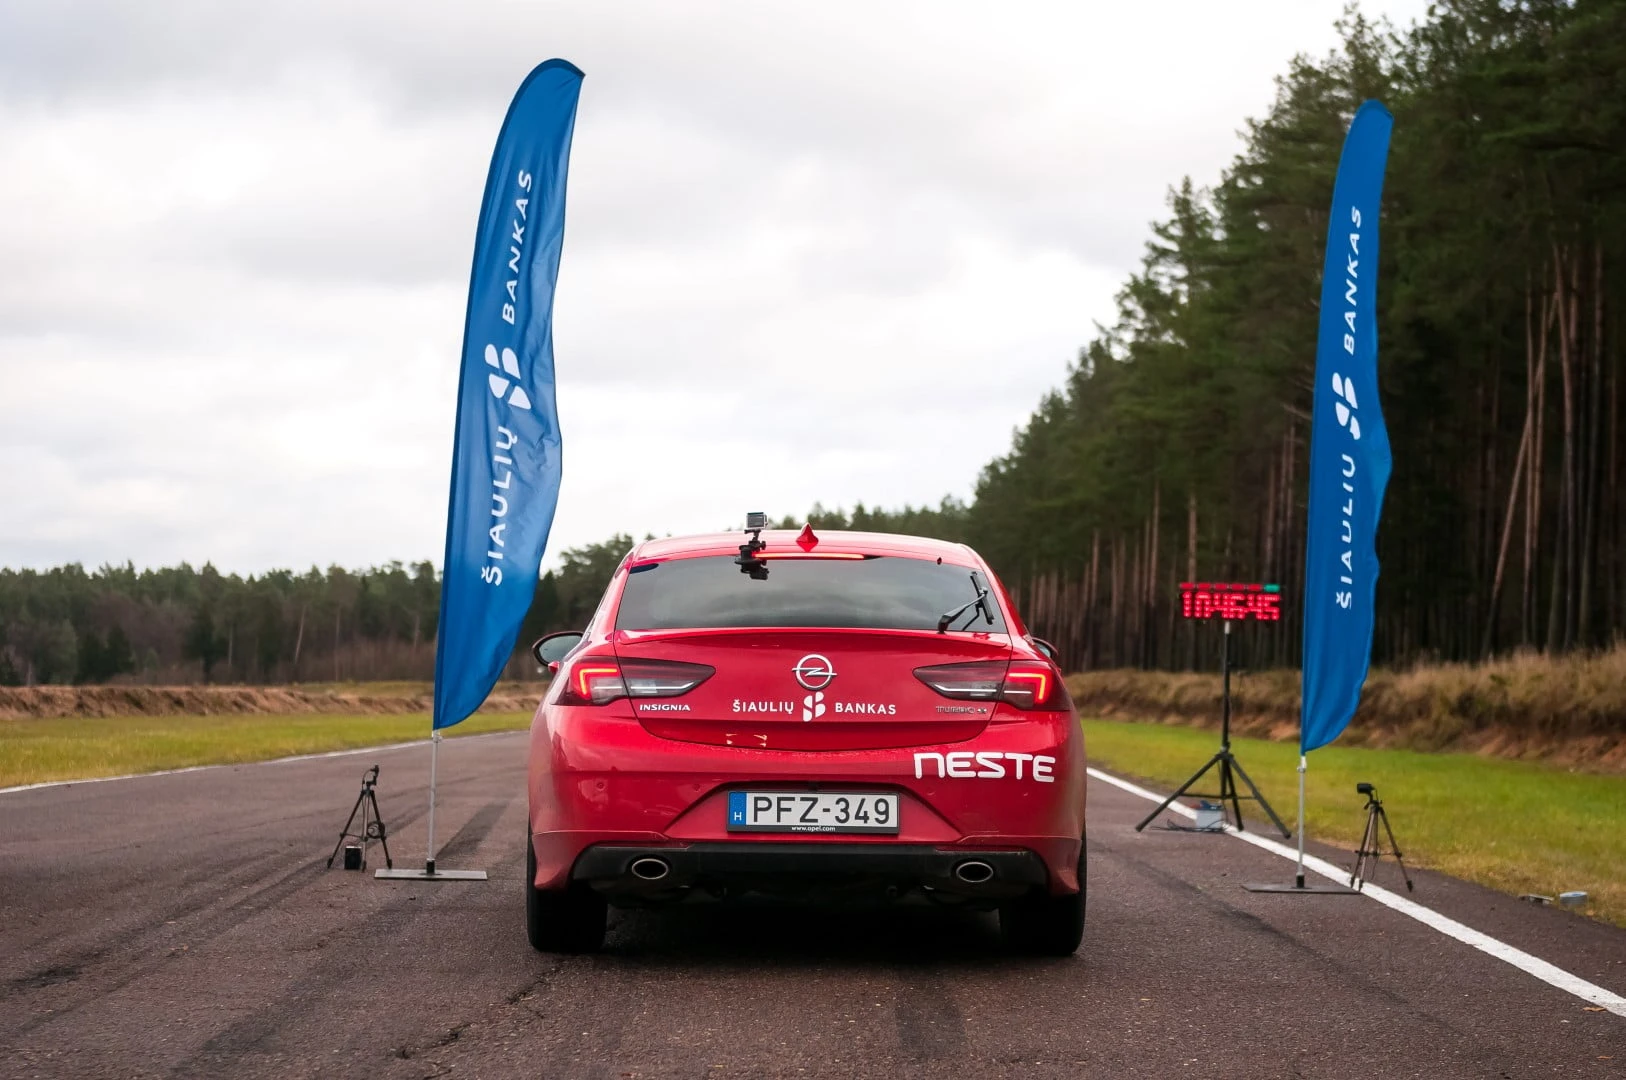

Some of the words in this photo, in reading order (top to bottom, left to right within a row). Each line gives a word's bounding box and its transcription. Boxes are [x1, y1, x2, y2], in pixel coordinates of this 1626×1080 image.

[1343, 206, 1361, 355] BANKAS
[481, 426, 518, 586] ŠIAULIŲ
[502, 169, 532, 324] BANKAS
[732, 699, 794, 714] ŠIAULIŲ
[835, 702, 896, 715] BANKAS
[914, 751, 1056, 783] NESTE
[734, 811, 742, 821] H
[753, 796, 890, 824] PFZ-349
[791, 824, 836, 832] www.opel.com
